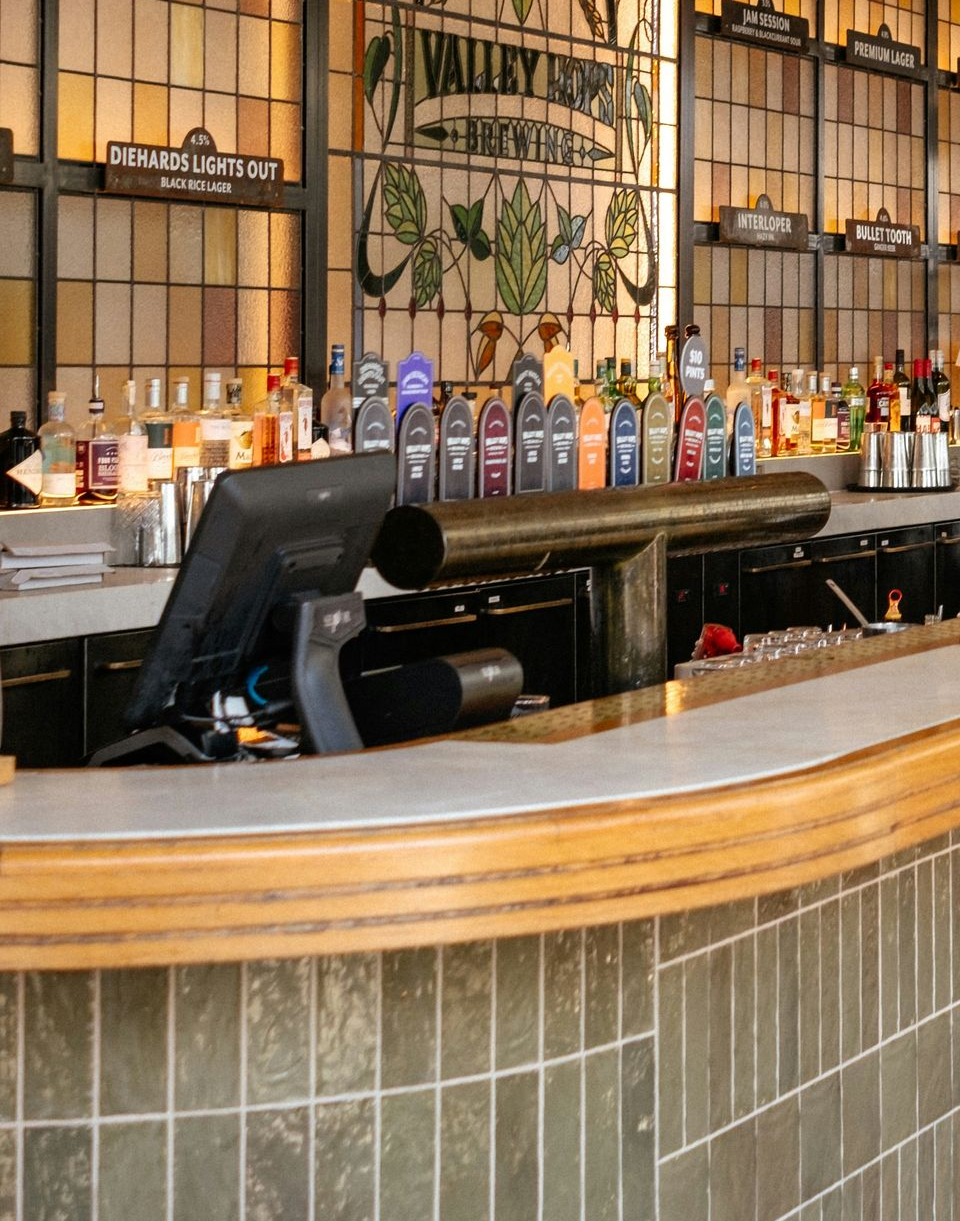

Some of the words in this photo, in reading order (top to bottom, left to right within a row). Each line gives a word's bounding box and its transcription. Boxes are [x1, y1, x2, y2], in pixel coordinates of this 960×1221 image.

[742, 8, 759, 26] JAM
[759, 12, 790, 32] SESSION
[420, 30, 541, 100] VALLEY
[854, 40, 890, 63] PREMIUM
[891, 49, 915, 69] LAGER
[190, 134, 210, 146] 4.5%
[466, 119, 574, 166] BREWING
[110, 145, 190, 173] DIEHARDS
[193, 154, 244, 178] LIGHTS
[247, 160, 278, 181] OUT
[160, 176, 187, 190] BLACK
[187, 179, 206, 191] RICE
[206, 181, 232, 194] LAGER
[737, 212, 792, 234] INTERLOPER
[856, 224, 885, 242] BULLET
[885, 227, 912, 246] TOOTH
[689, 348, 703, 365] $10
[685, 365, 705, 380] PINTS
